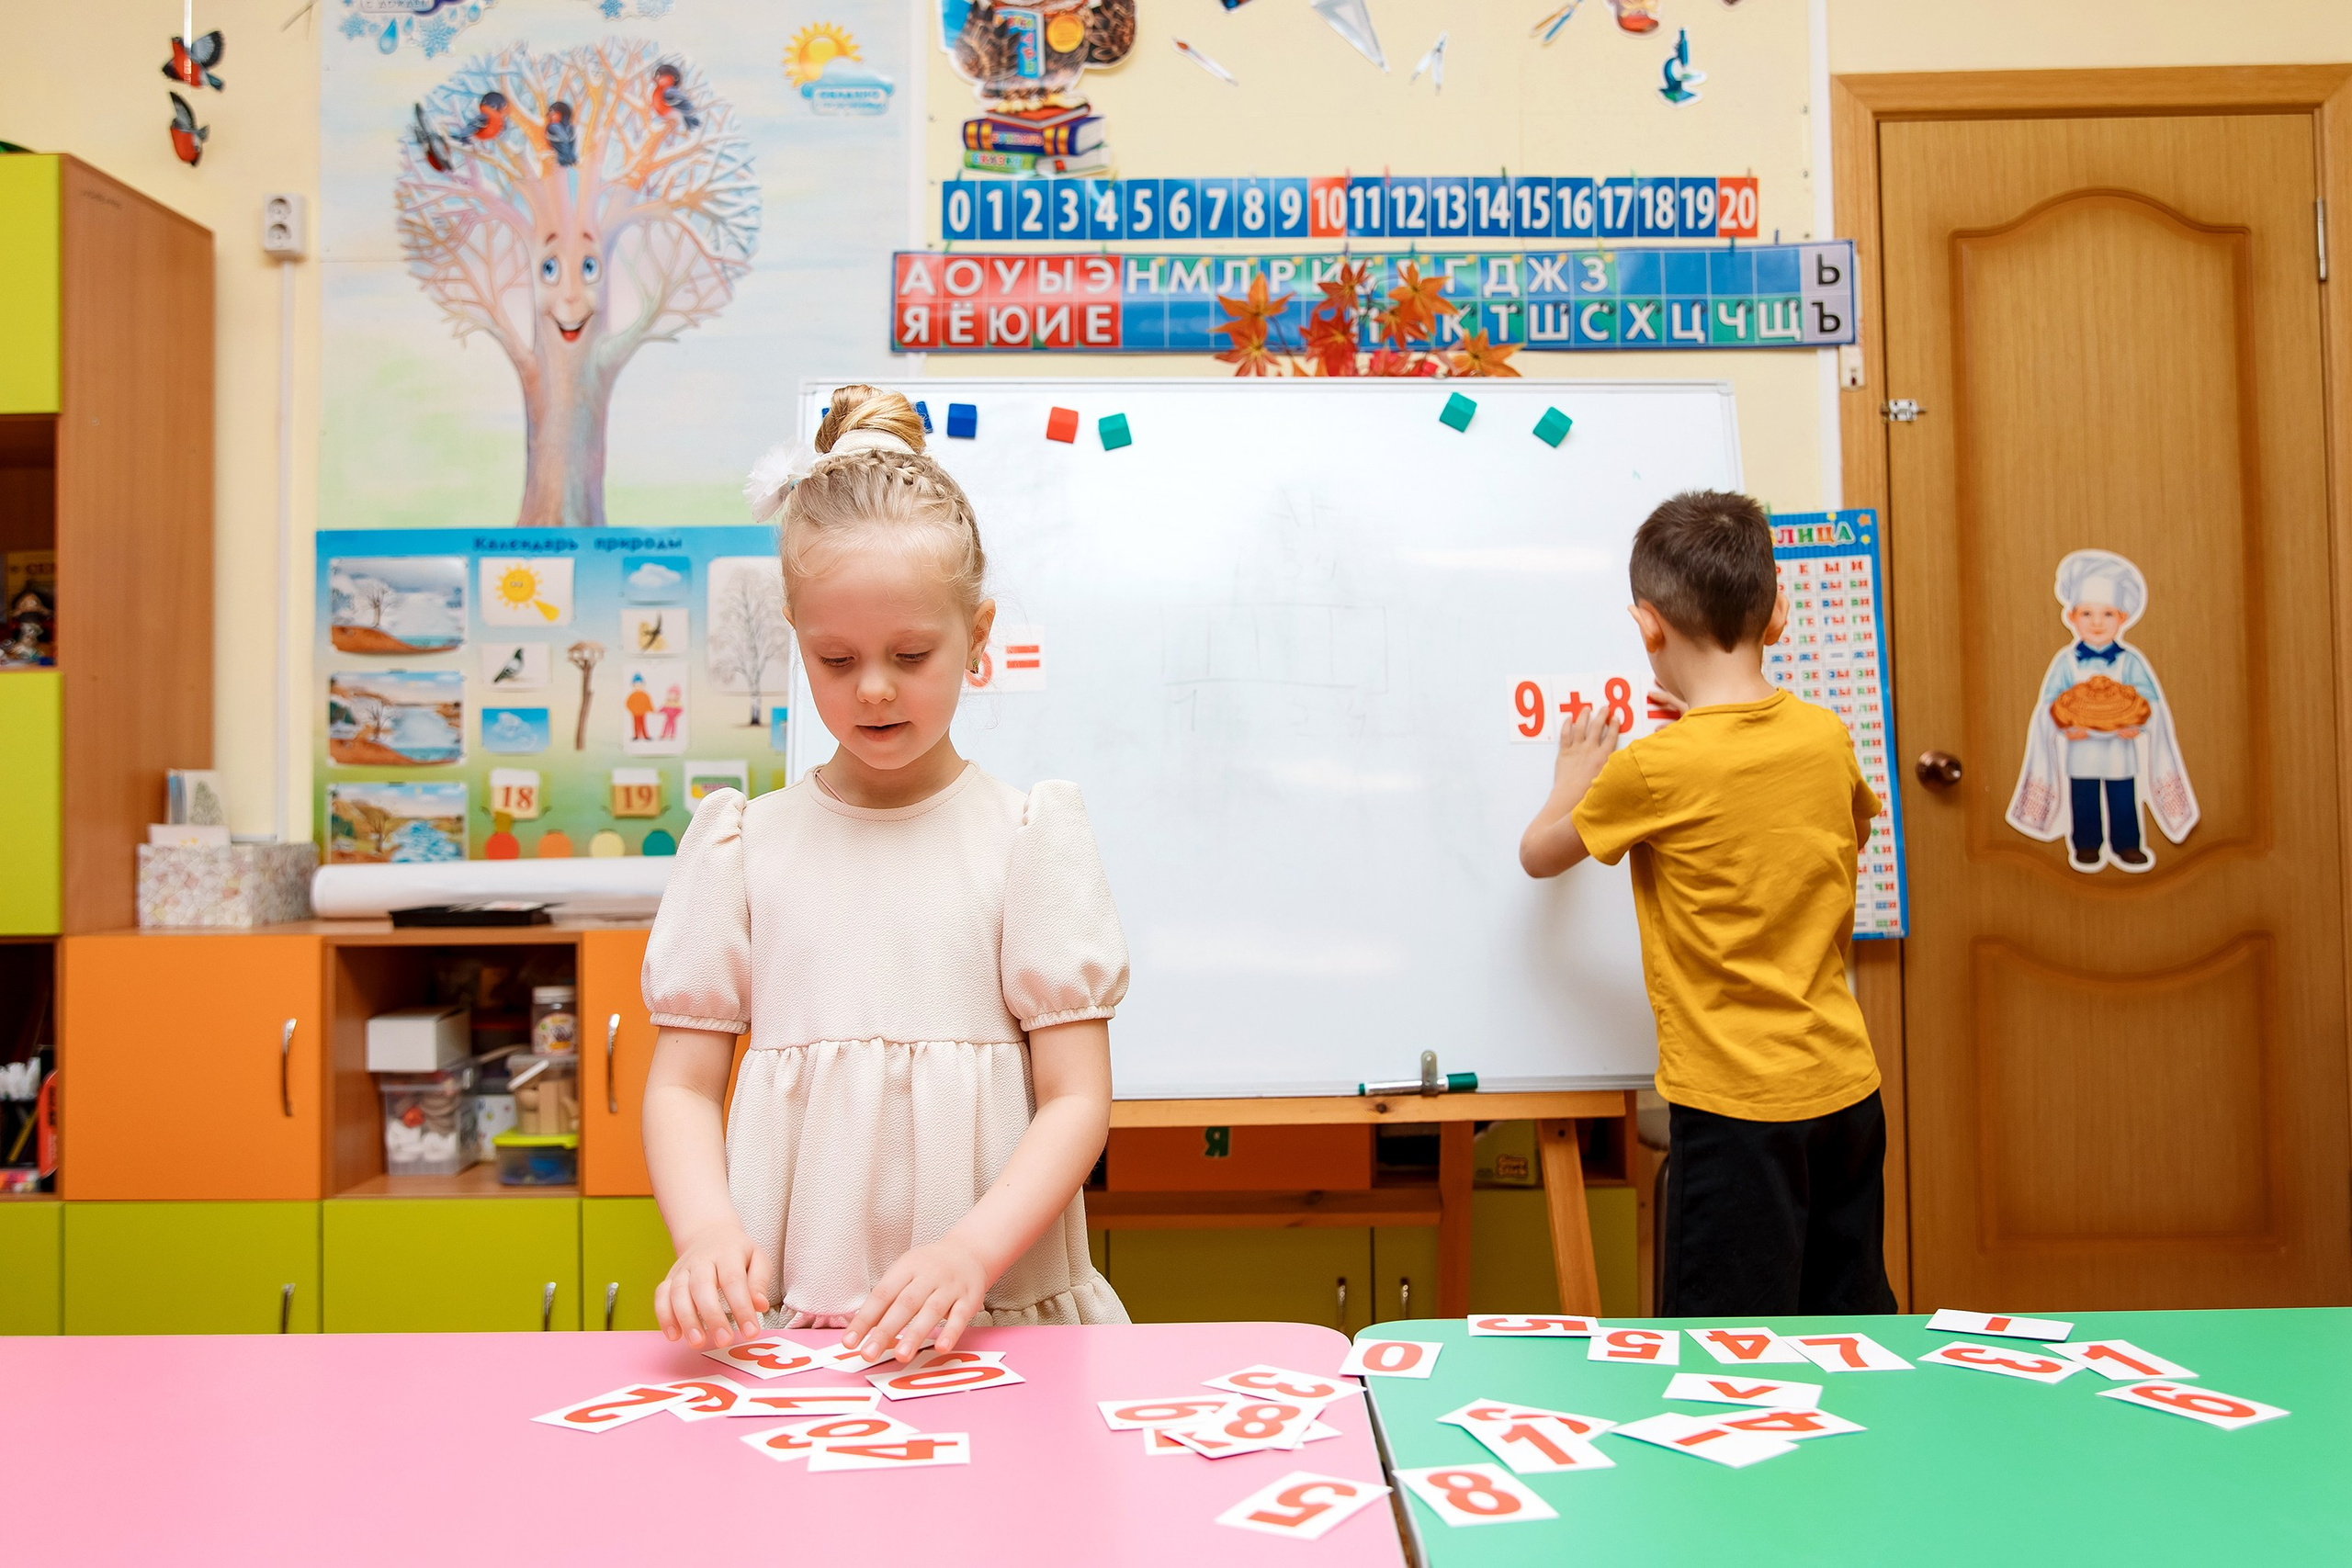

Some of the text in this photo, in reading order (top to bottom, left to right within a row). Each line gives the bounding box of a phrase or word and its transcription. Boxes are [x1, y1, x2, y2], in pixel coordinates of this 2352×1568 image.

[949, 185, 1757, 231] 0 1 2 3 4 5 6 7 8 9 10 11 12 13 14 15 16 17 18 19 20
[1770, 525, 1854, 545] ЛИЦА
[502, 784, 534, 810] 18
[622, 784, 653, 810] 19
[1363, 1341, 1423, 1371] 0
[1606, 1330, 1665, 1360] 5
[1706, 1330, 1771, 1360] 4
[2081, 1344, 2165, 1376] 1
[888, 1366, 1006, 1390] 0
[1223, 1404, 1301, 1439] 8
[825, 1438, 959, 1461] 4
[1499, 1423, 1578, 1465] 1
[1246, 1481, 1357, 1528] 5
[1426, 1471, 1522, 1516] 8
